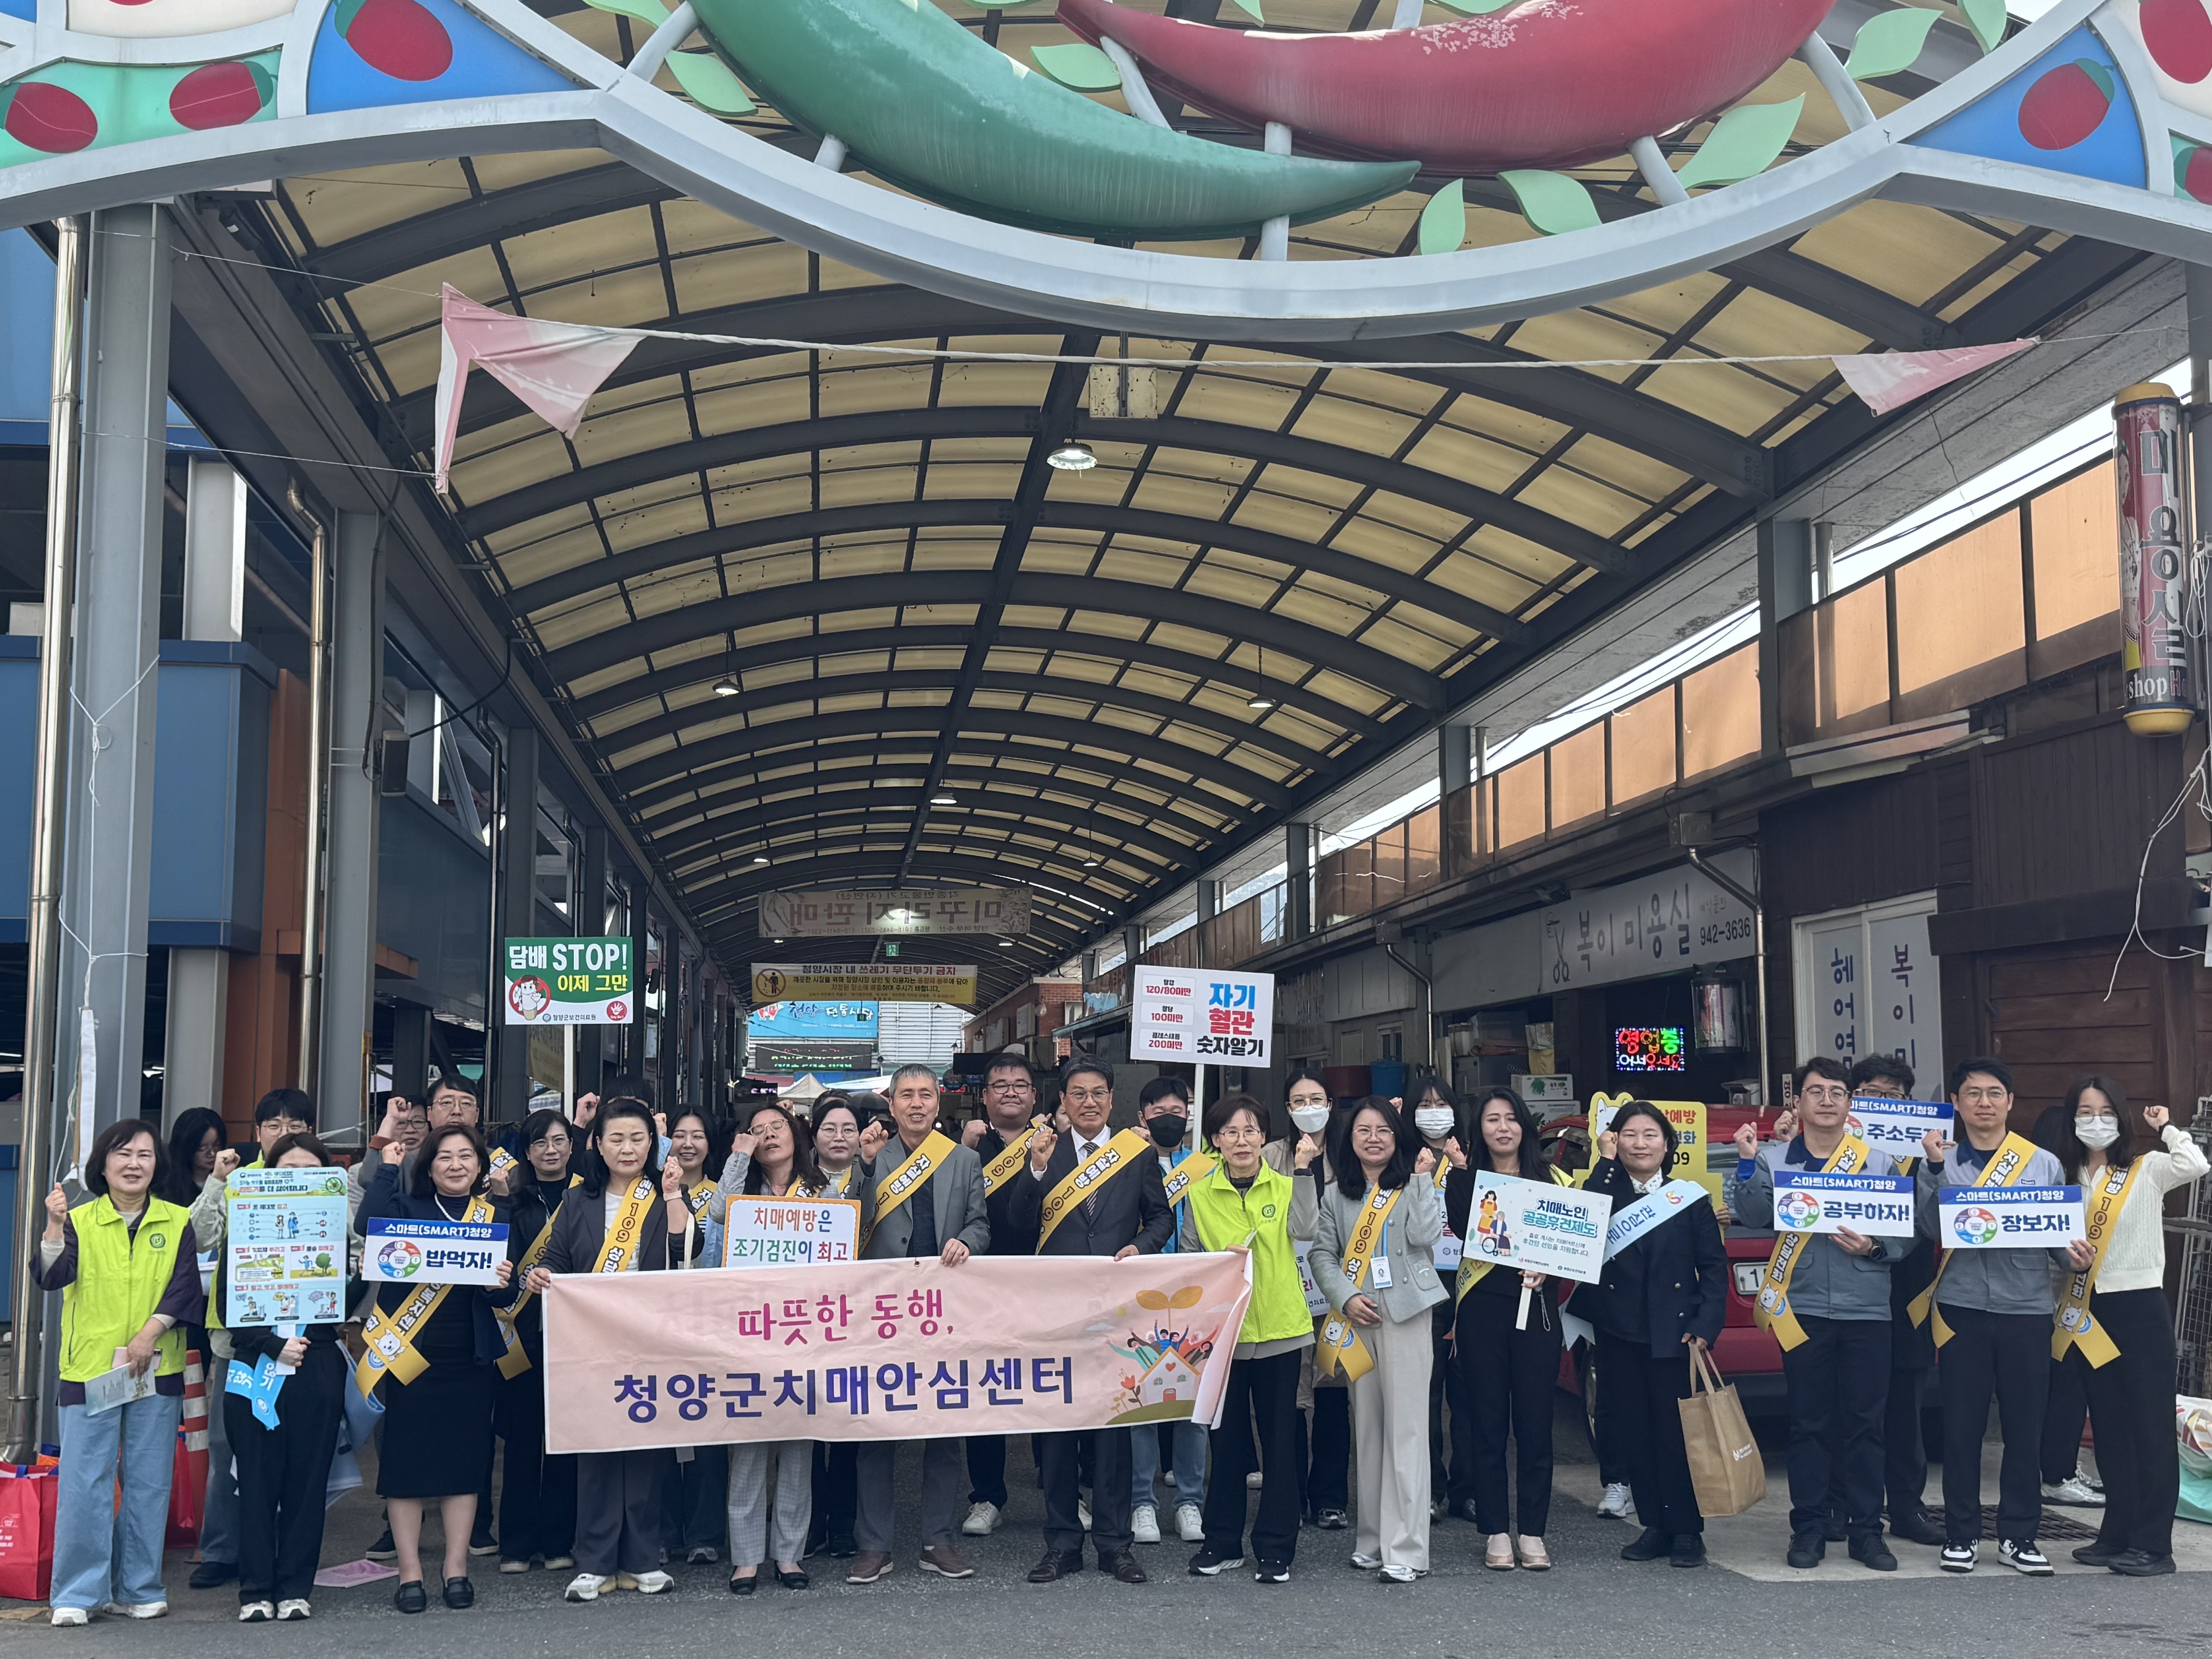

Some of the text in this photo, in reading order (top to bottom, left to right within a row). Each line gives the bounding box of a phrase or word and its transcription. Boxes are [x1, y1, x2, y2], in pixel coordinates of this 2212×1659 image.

[2129, 672, 2168, 702] shop
[1625, 883, 1691, 959] 미용실
[1700, 917, 1751, 946] 942-3636
[509, 943, 627, 971] 담배 STOP!
[802, 965, 956, 975] 청양시장 내 쓰레기 무단투기 금지
[558, 975, 628, 992] 이제 그만
[1146, 985, 1191, 996] 120/80미만
[1209, 983, 1256, 1009] 자기
[1151, 1012, 1184, 1023] 100미만
[1209, 1008, 1255, 1036] 혈관
[1149, 1040, 1183, 1050] 200미만
[1197, 1035, 1264, 1057] 숫자알기
[1618, 1028, 1680, 1054] 영업중
[1850, 1100, 1938, 1116] 마트(SMART)청양
[1867, 1123, 1947, 1143] 주소두!
[889, 1153, 932, 1196] 자살예방
[1042, 1148, 1121, 1221] 자살예방 109
[1790, 1176, 1896, 1190] 스마트(SMART)청양
[633, 1178, 653, 1201] 예방
[1955, 1191, 2064, 1203] 스마트(SMART)청양
[753, 1207, 833, 1233] 치매예방은
[1537, 1199, 1586, 1220] 치매노인
[1823, 1201, 1910, 1222] 공부하자!
[384, 1223, 493, 1238] 스마트(SMART)청양
[615, 1203, 639, 1243] 109
[1353, 1212, 1376, 1254] 109
[1523, 1210, 1596, 1236] 공공후견제도
[2001, 1214, 2070, 1232] 장보자!
[426, 1250, 493, 1270] 밥먹자!
[732, 1238, 849, 1264] 조기검진이 최고
[738, 1289, 954, 1346] 따뜻한 동행,
[614, 1356, 1073, 1423] 청양군치매안심센터
